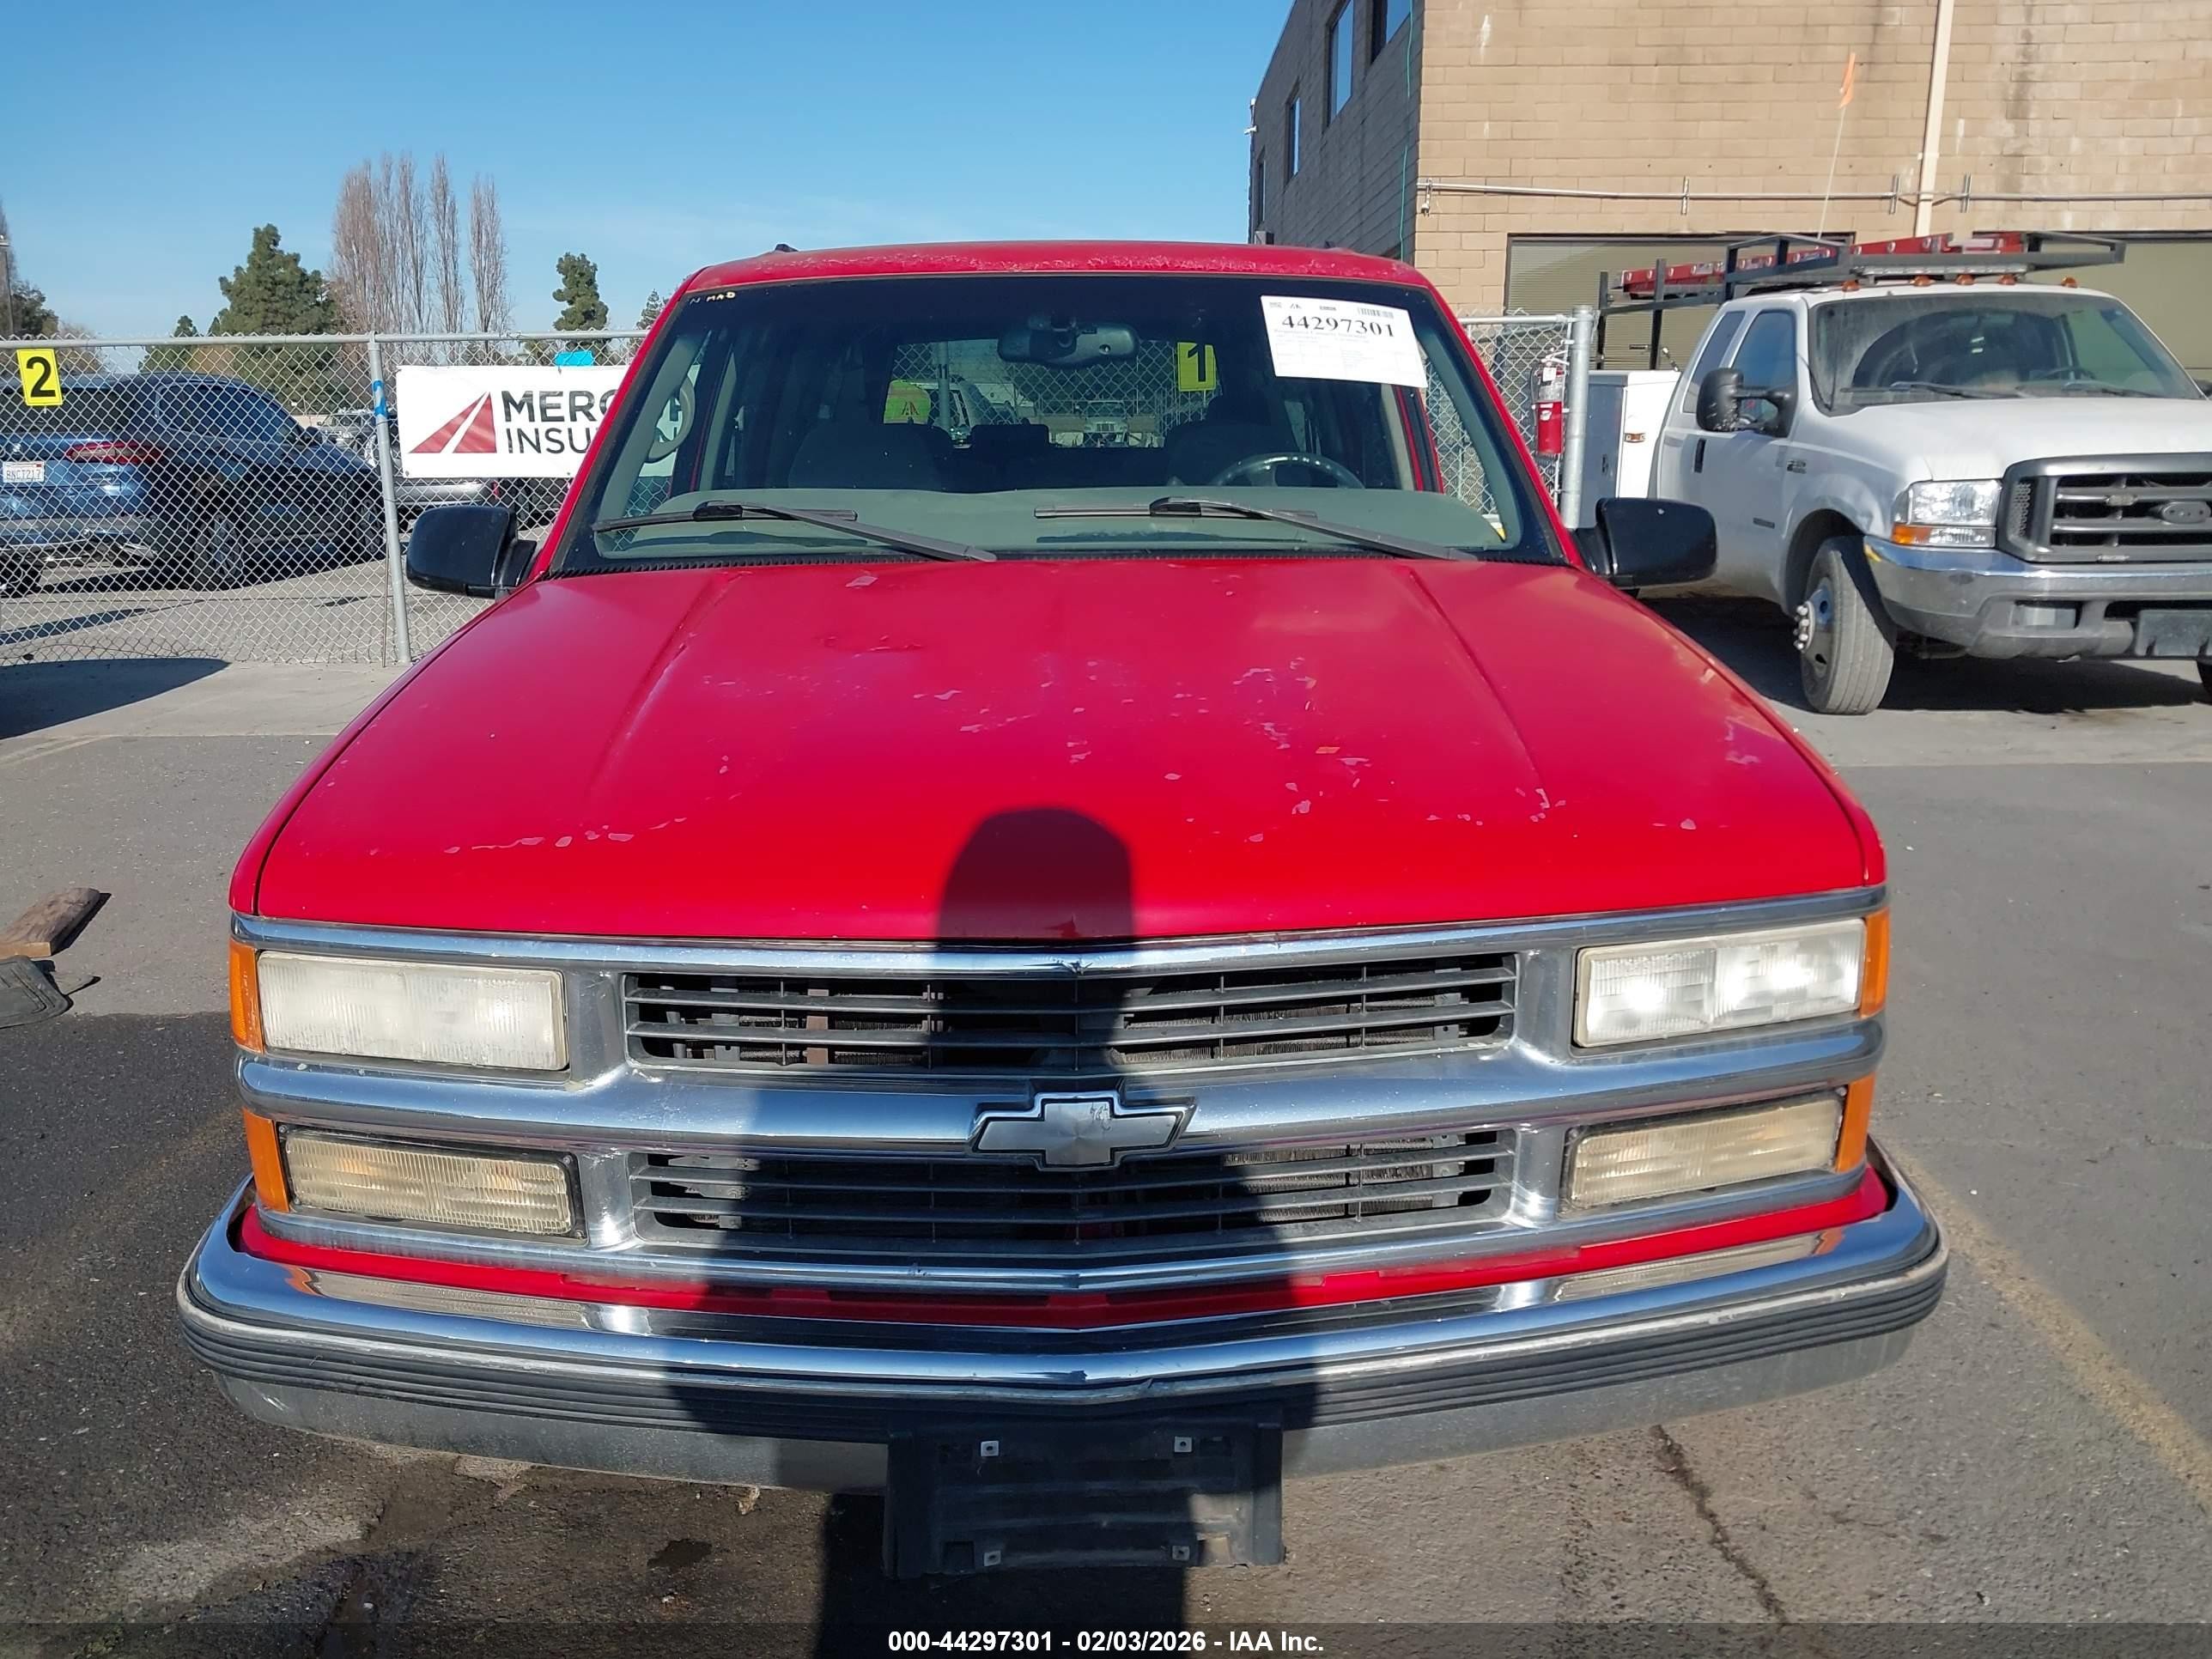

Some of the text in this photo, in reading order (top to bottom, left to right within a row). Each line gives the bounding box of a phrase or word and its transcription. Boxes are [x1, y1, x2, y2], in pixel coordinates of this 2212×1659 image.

[1281, 315, 1395, 337] 44297301
[26, 356, 57, 398] 2
[1187, 343, 1206, 383] 1
